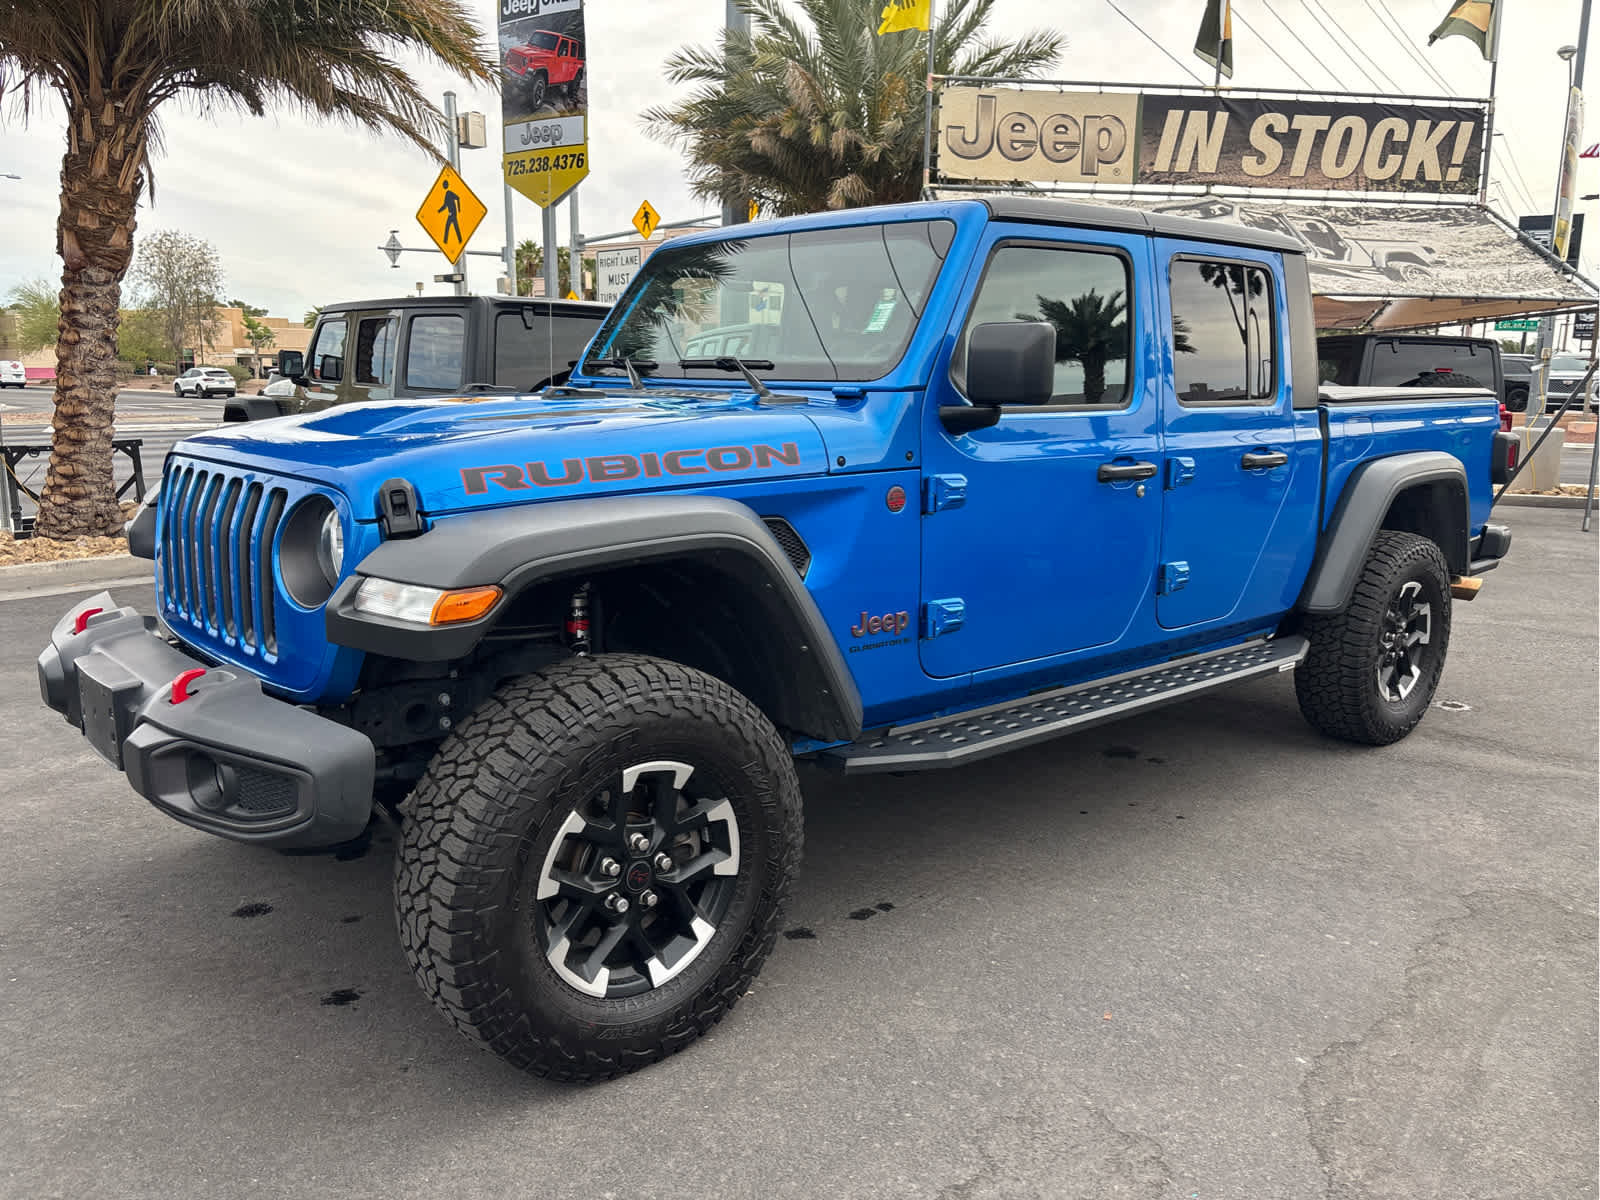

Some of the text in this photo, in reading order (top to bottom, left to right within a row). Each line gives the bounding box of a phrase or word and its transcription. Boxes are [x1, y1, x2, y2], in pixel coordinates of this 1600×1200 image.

[503, 0, 538, 15] Jeep
[521, 123, 563, 145] Jeep
[946, 95, 1127, 176] Jeep
[1153, 110, 1475, 182] IN STOCK!
[507, 153, 585, 176] 725.238.4376
[600, 255, 639, 267] RIGHT LANE
[608, 272, 630, 286] MUST
[460, 442, 800, 495] RUBICON
[851, 610, 909, 638] Jeep
